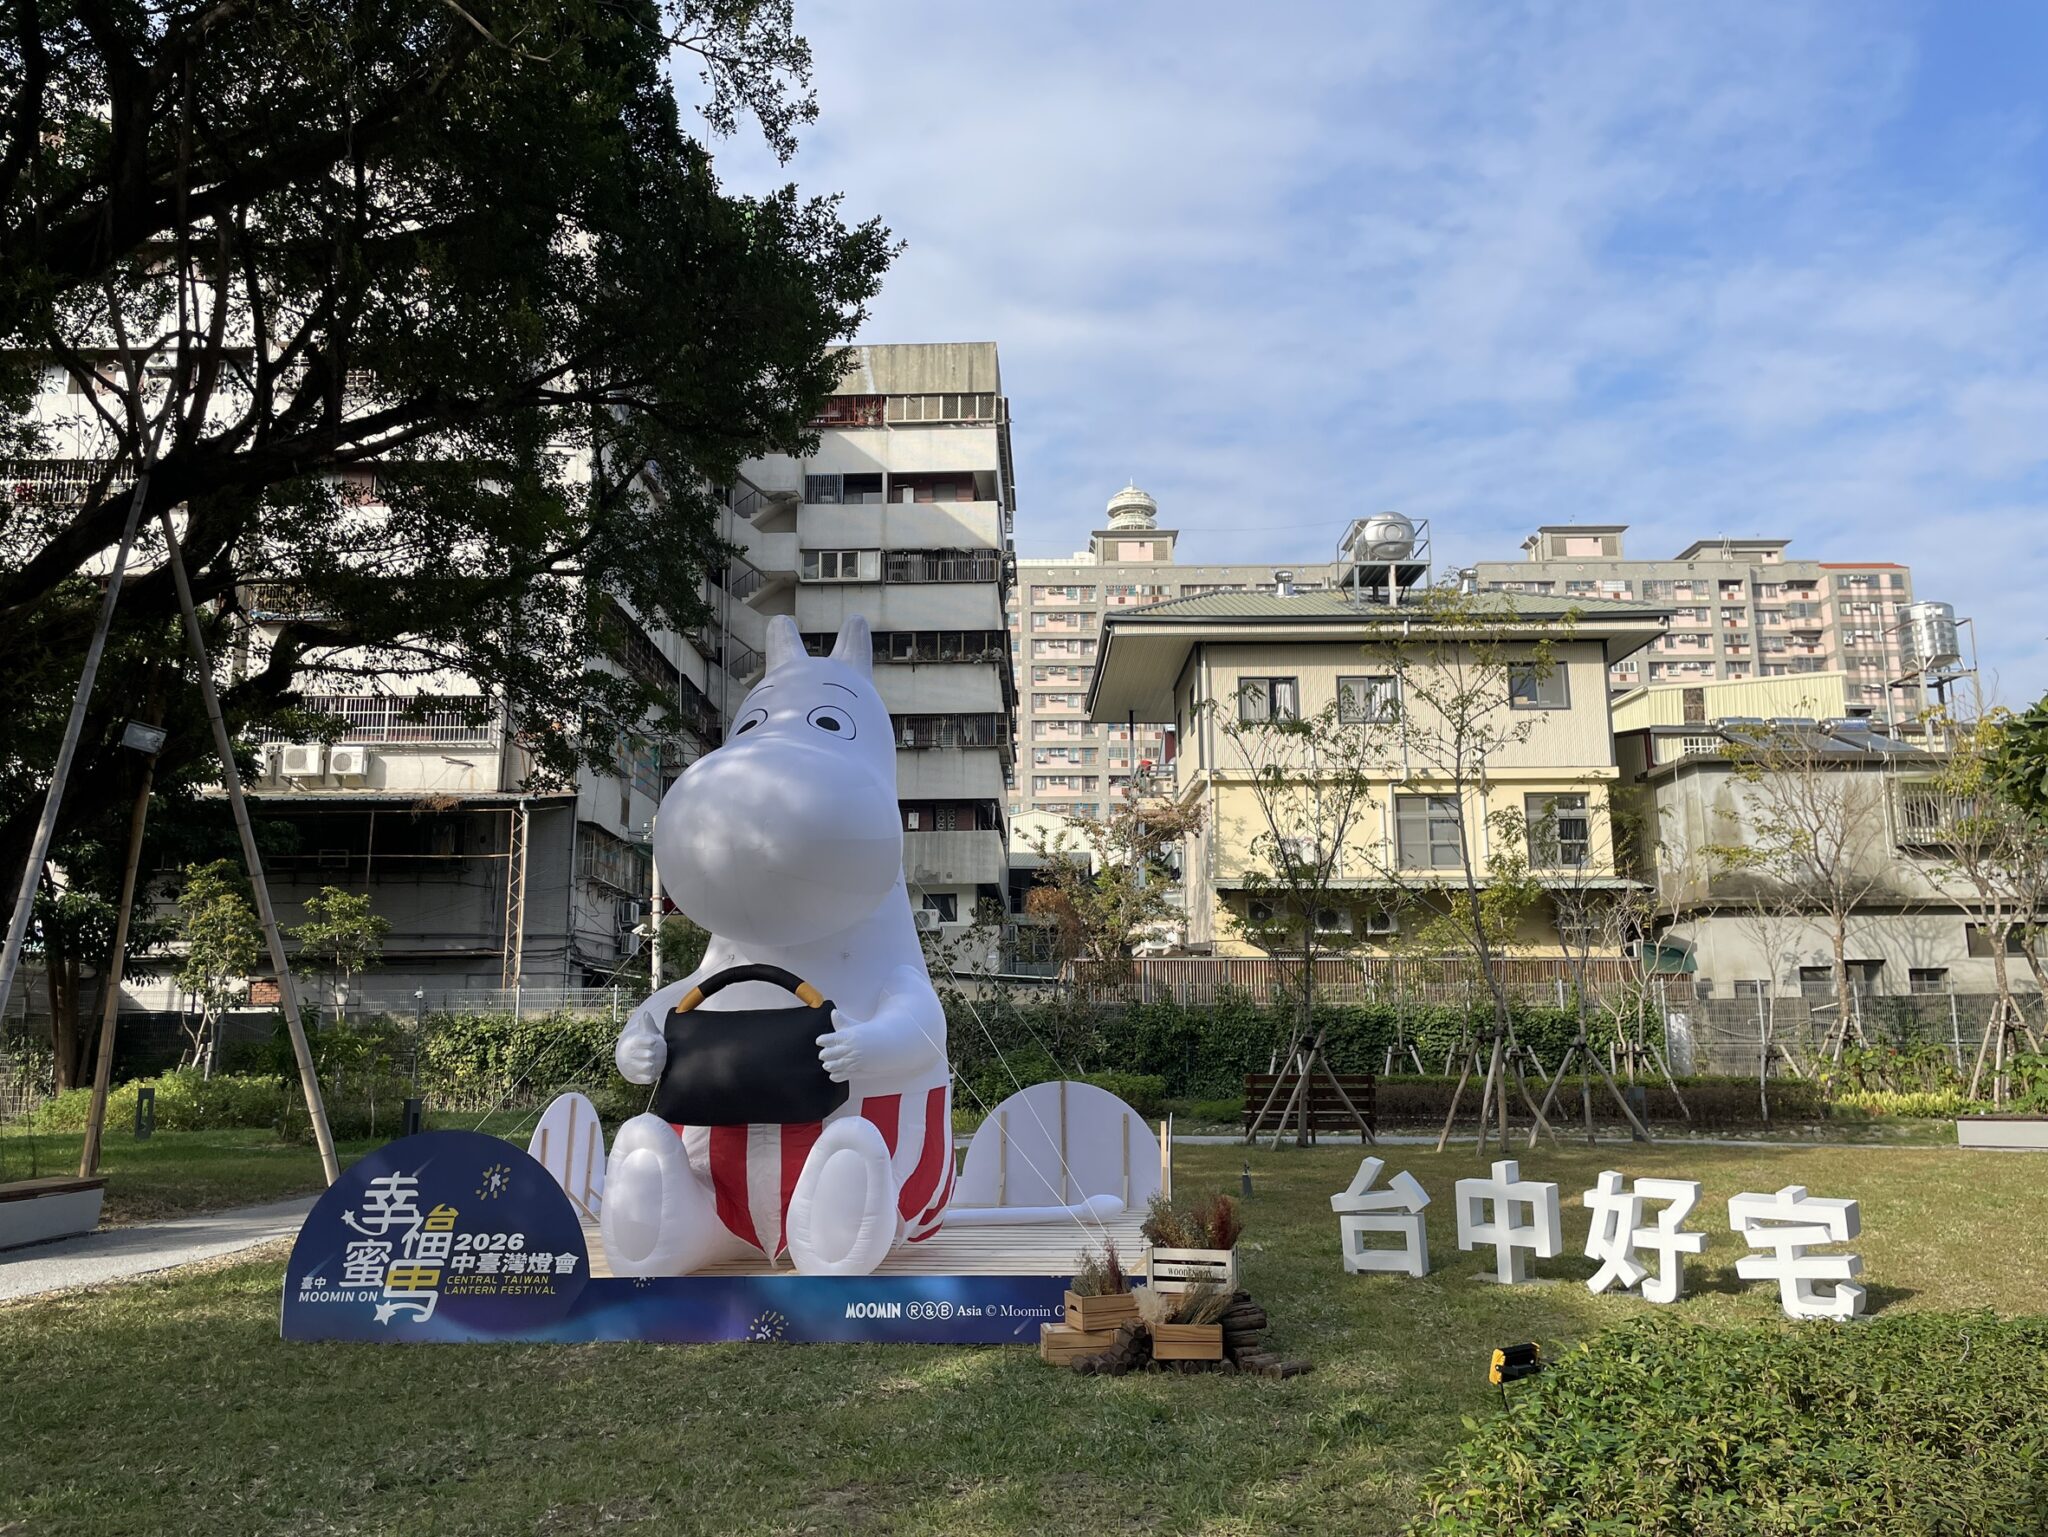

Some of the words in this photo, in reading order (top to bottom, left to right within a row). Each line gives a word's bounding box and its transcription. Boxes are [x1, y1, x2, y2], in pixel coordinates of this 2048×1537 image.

[454, 1233, 525, 1251] 2026
[1331, 1156, 1867, 1322] 台中好宅
[450, 1252, 580, 1275] 中臺灣燈會
[300, 1276, 327, 1290] 臺中
[446, 1275, 498, 1285] CENTRAL
[504, 1275, 549, 1285] TAIWAN
[298, 1291, 356, 1303] MOOMIN
[358, 1291, 378, 1303] ON
[444, 1285, 497, 1295] LANTERN
[500, 1285, 557, 1295] FESTIVAL
[845, 1302, 901, 1319] MOOMIN
[957, 1304, 982, 1317] Asia
[1000, 1304, 1051, 1317] Moomin
